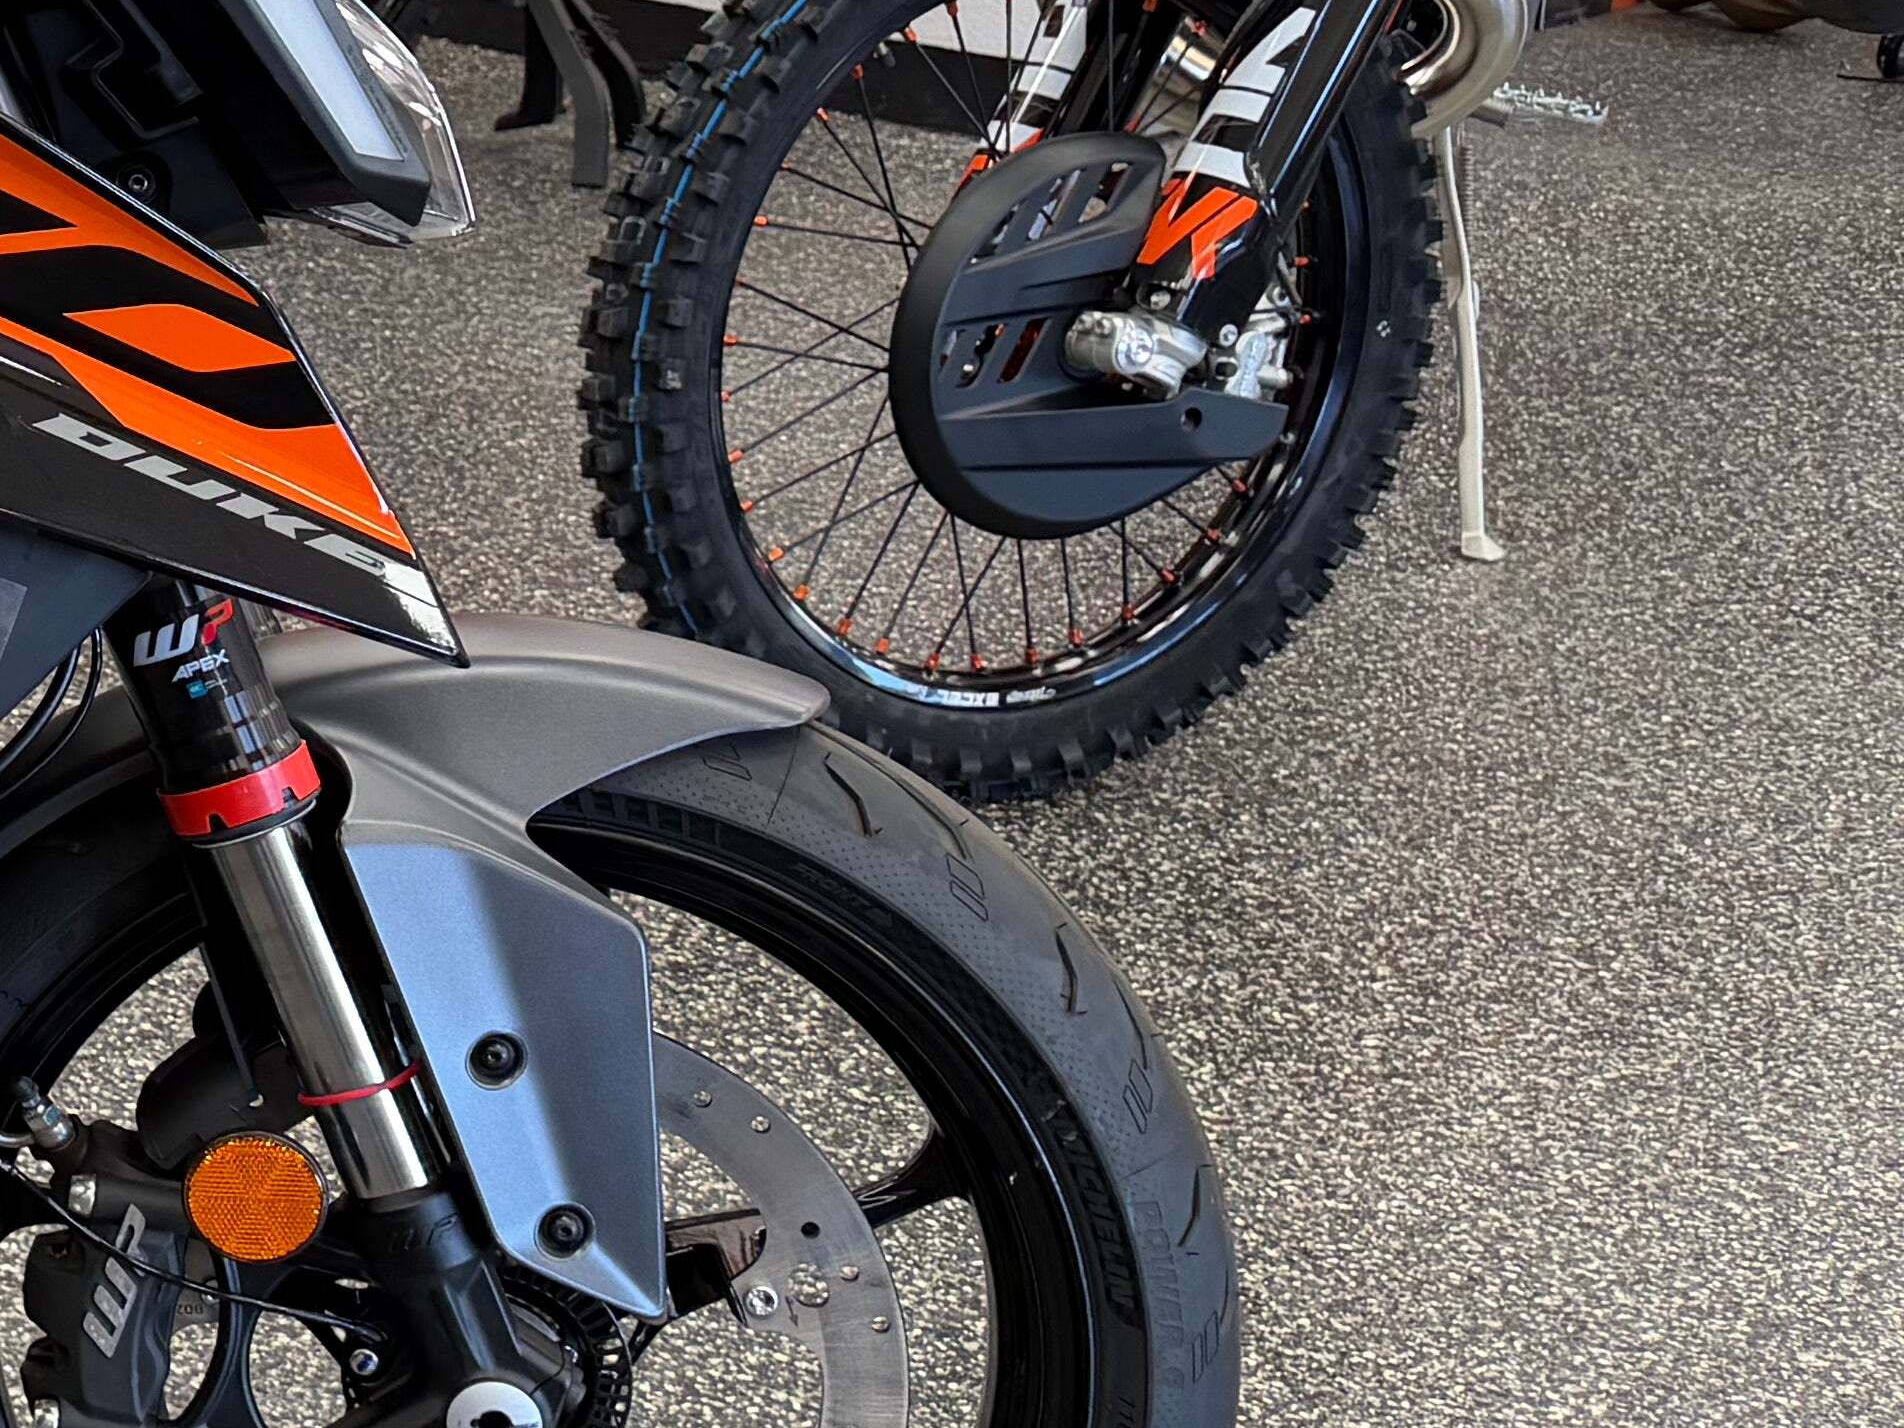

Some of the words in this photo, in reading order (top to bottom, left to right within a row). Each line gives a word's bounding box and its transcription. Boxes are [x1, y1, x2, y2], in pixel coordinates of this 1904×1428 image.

[33, 412, 390, 578] DUKE
[133, 597, 235, 667] WP
[172, 648, 230, 683] APEX
[82, 1203, 149, 1359] WP
[1135, 1200, 1184, 1349] POWER
[1163, 1366, 1185, 1390] 6
